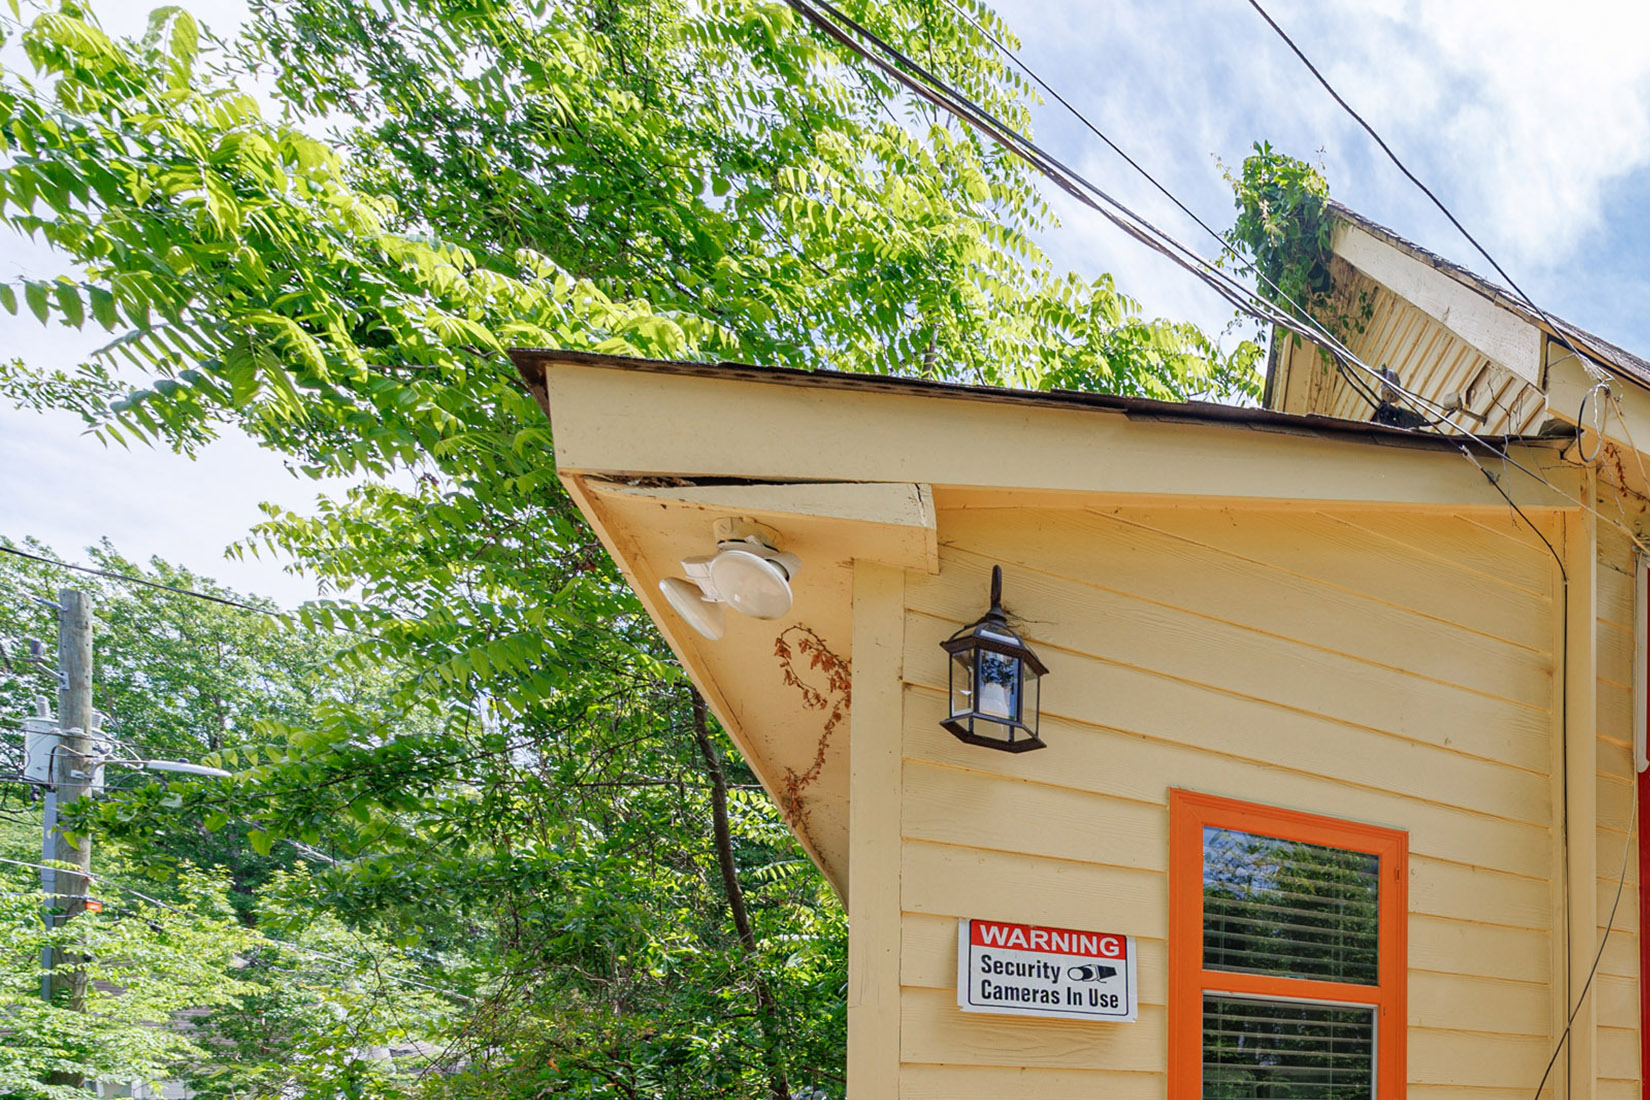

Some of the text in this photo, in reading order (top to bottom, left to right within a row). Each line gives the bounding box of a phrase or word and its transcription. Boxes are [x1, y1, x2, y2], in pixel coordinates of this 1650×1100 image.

[979, 924, 1120, 957] WARNING
[981, 954, 1061, 984] Security
[981, 979, 1119, 1009] Cameras In Use
